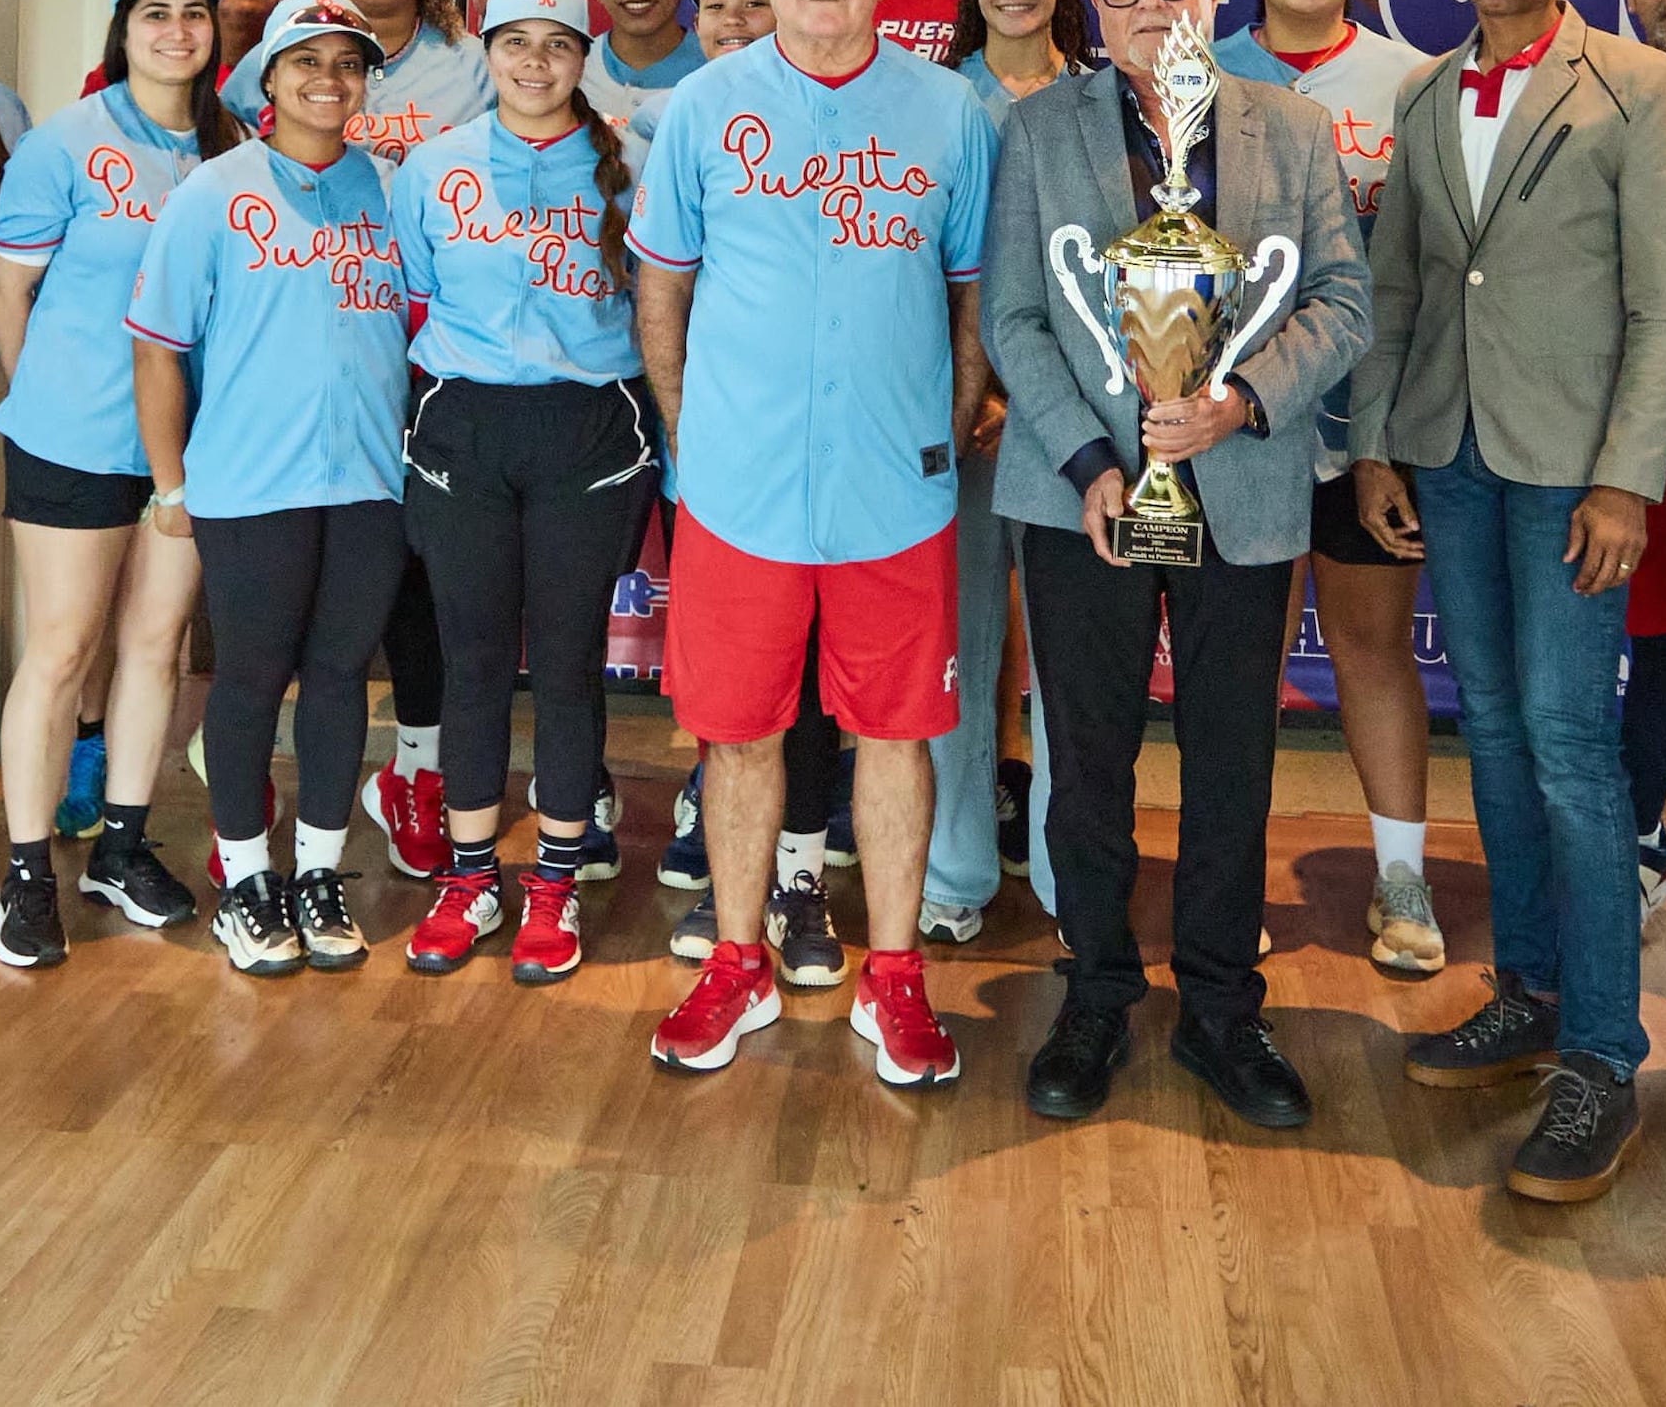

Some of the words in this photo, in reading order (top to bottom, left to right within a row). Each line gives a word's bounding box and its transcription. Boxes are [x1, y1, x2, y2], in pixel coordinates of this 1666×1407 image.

[877, 20, 955, 42] PUER
[721, 112, 938, 200] Puerto
[437, 167, 602, 248] Puert
[820, 183, 926, 252] Rico
